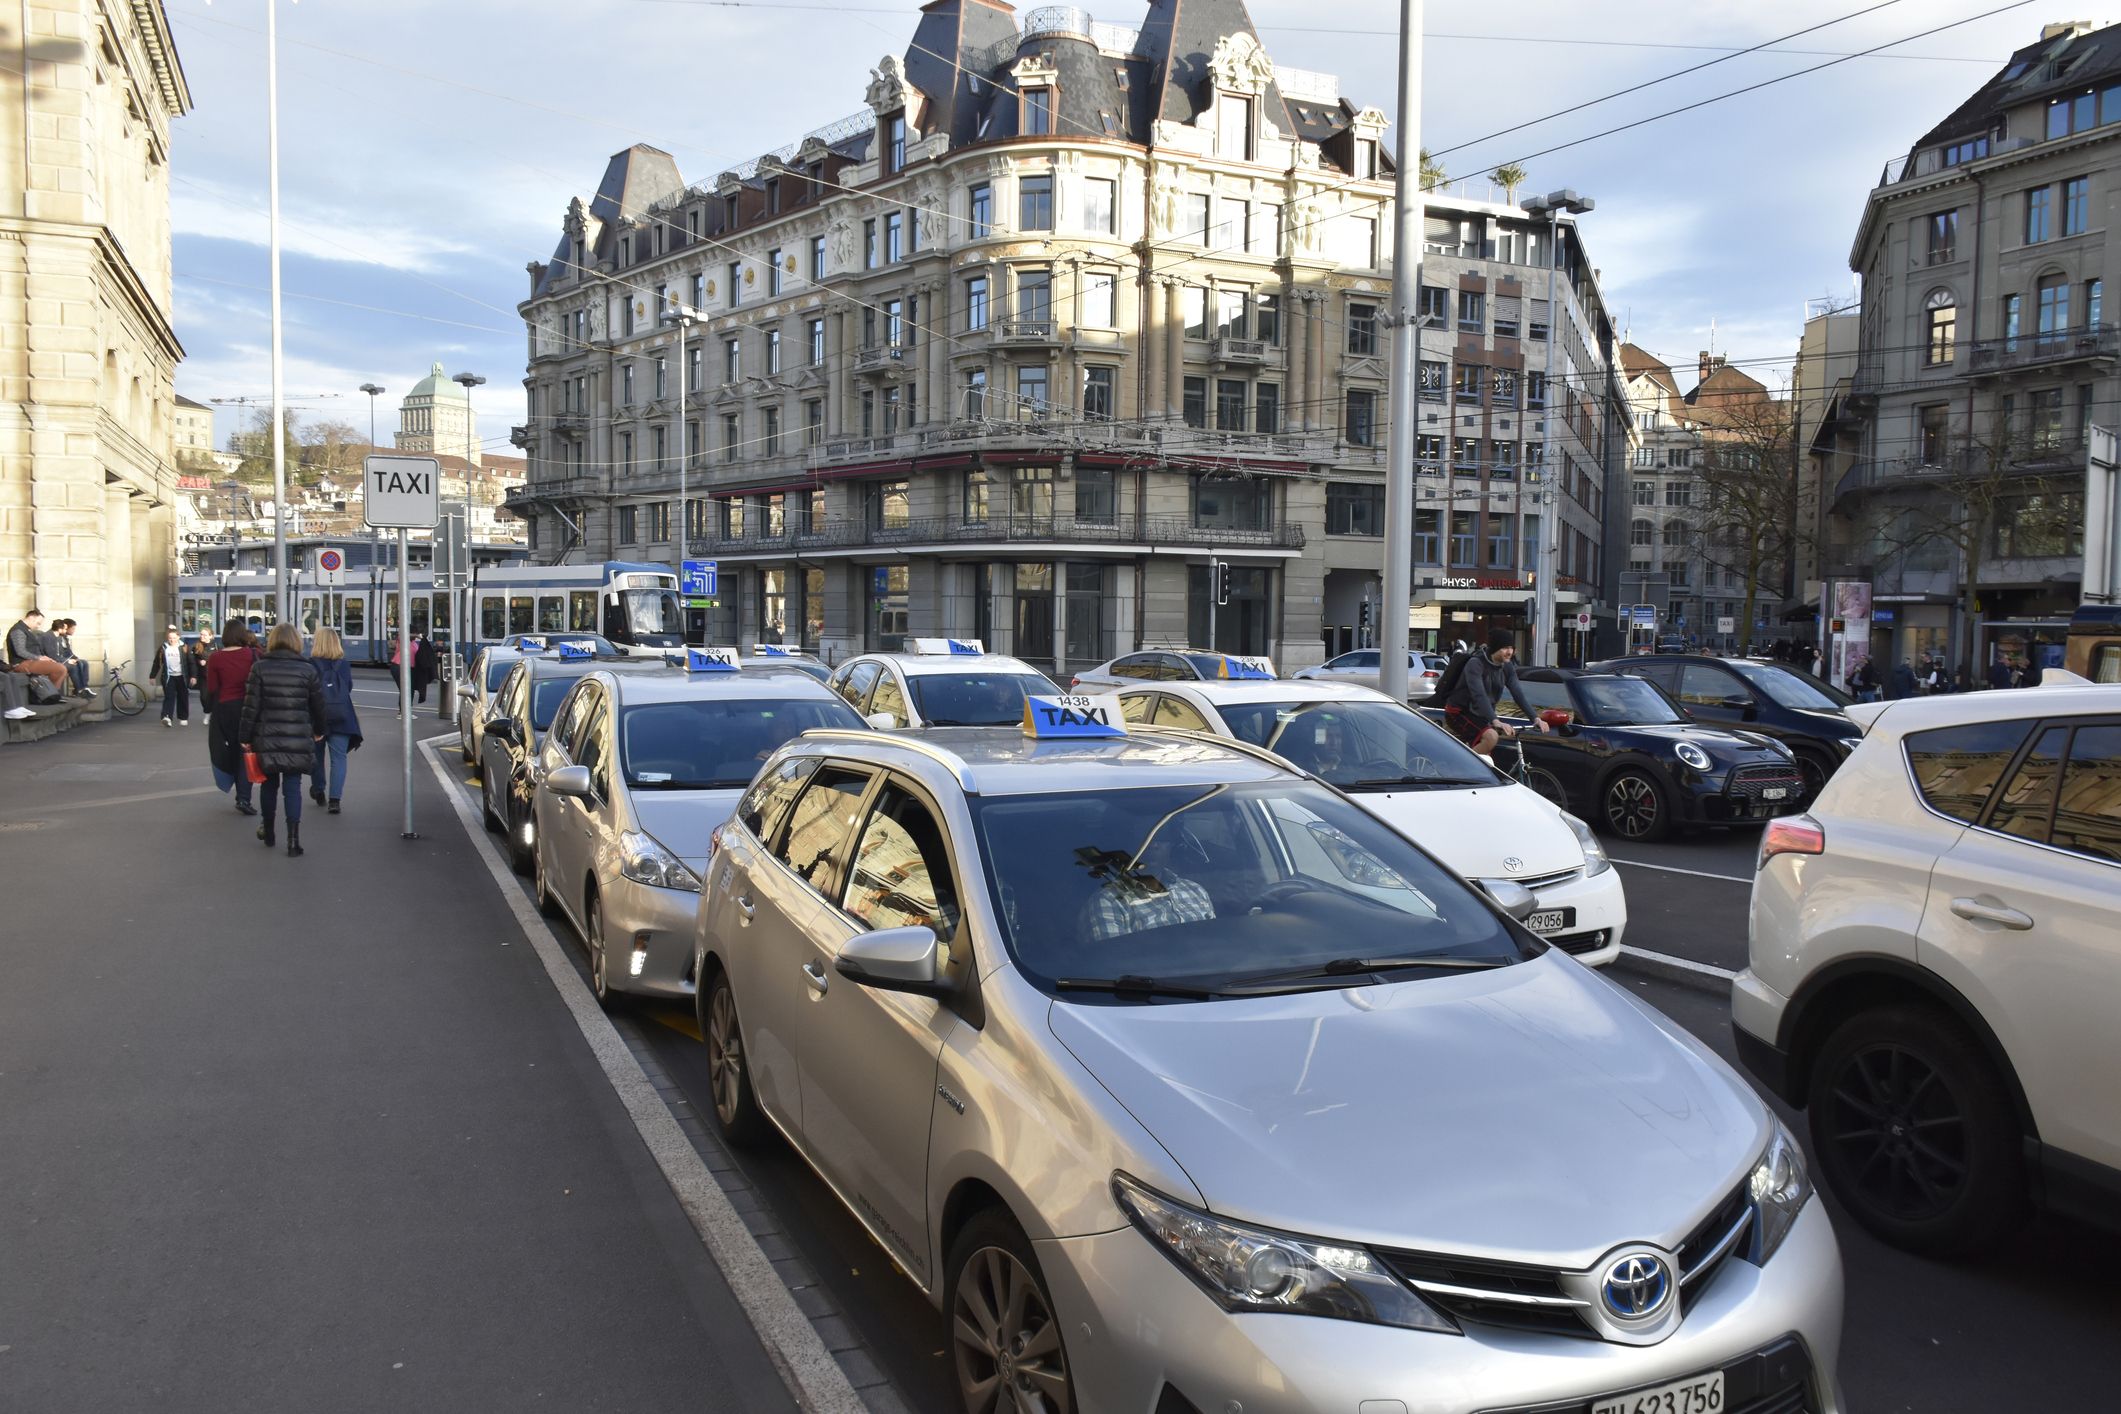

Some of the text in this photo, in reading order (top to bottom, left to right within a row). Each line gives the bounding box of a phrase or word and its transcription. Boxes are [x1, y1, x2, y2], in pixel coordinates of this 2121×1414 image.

[176, 475, 211, 489] PARI
[373, 471, 430, 494] TAXI
[564, 647, 591, 655] TAXI
[953, 644, 979, 653] TAXI
[694, 655, 731, 665] TAXI
[1230, 662, 1266, 673] TAXI
[1056, 696, 1090, 706] 1438
[1040, 708, 1109, 726] TAXI
